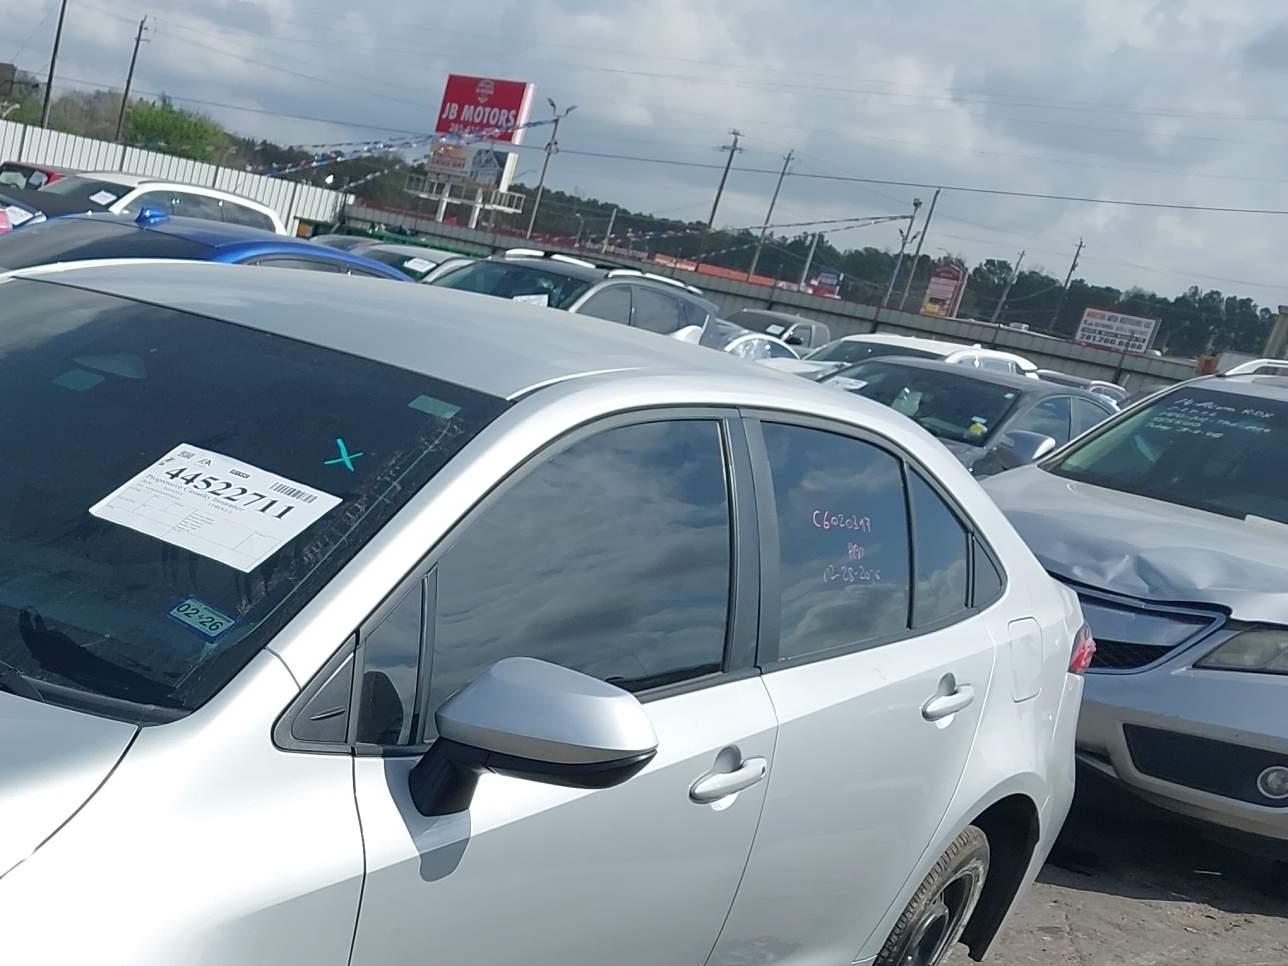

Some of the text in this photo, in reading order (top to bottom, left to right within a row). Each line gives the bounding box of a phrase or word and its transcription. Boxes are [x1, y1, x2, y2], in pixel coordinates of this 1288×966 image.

[441, 102, 517, 126] JB MOTORS
[164, 466, 295, 520] 44522711
